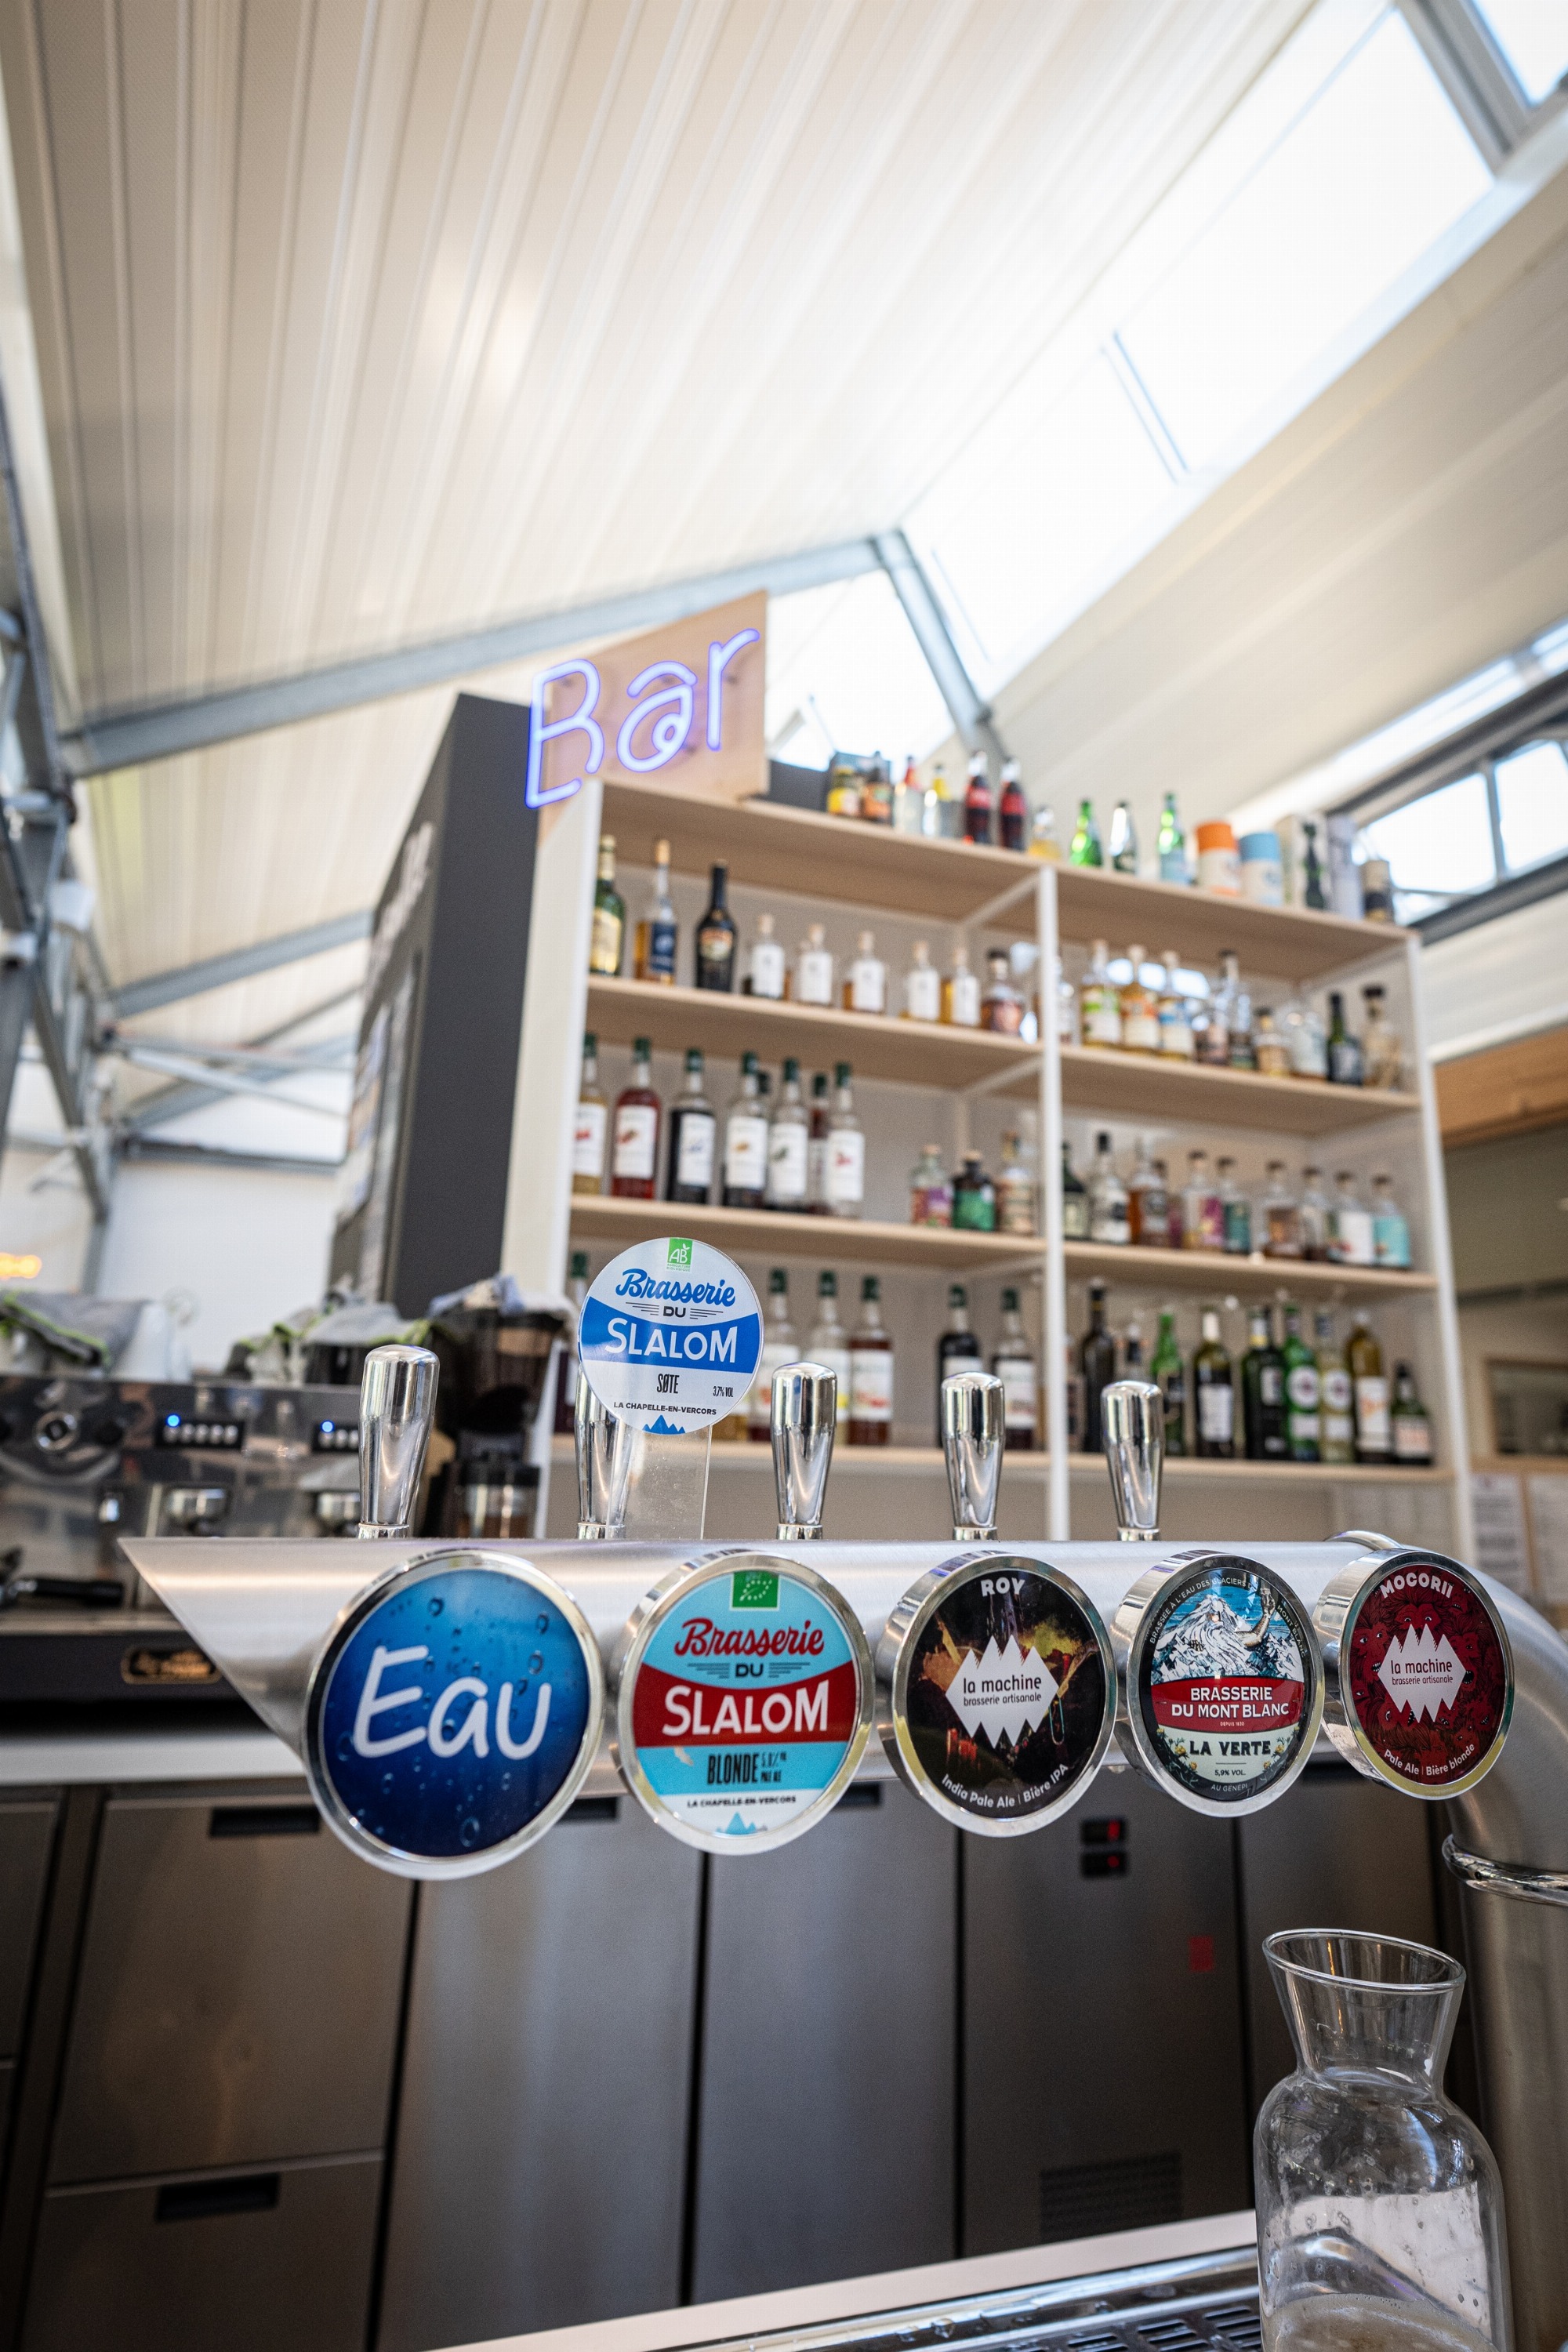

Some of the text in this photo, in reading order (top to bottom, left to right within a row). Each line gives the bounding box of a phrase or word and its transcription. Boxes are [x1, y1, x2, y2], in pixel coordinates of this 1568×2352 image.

[524, 628, 760, 809] Bar
[669, 1248, 688, 1263] AB
[615, 1268, 735, 1307] Brasserie
[662, 1305, 686, 1318] DU
[604, 1317, 738, 1363] SLALOM
[656, 1373, 680, 1394] SØTE
[725, 1387, 734, 1398] VOL
[625, 1402, 717, 1416] CHAPELLE-EN-VERCORS
[980, 1576, 1025, 1597] ROY
[1196, 1578, 1211, 1590] DES
[1211, 1577, 1247, 1588] GLACIERS
[1276, 1605, 1294, 1628] MONT
[1290, 1626, 1306, 1658] BLANC
[673, 1617, 826, 1657] Brasserie
[735, 1663, 764, 1679] DU
[1390, 1658, 1453, 1675] la machine
[963, 1675, 1043, 1694] la machine
[1392, 1674, 1454, 1686] brasserie artisanale
[353, 1645, 552, 1761] Eau
[963, 1692, 1042, 1707] brasserie artisanale
[1190, 1686, 1273, 1702] BRASSERIE
[662, 1679, 830, 1737] SLALOM
[1171, 1702, 1290, 1719] DU MONT BLANC
[1189, 1740, 1272, 1757] LA VERTE
[706, 1752, 759, 1785] BLONDE
[1384, 1744, 1475, 1777] Pale Ale Bière blonde
[1214, 1769, 1230, 1777] 5,9%
[941, 1762, 1069, 1809] India Pale Ale Bière IPA
[1210, 1784, 1221, 1792] AU
